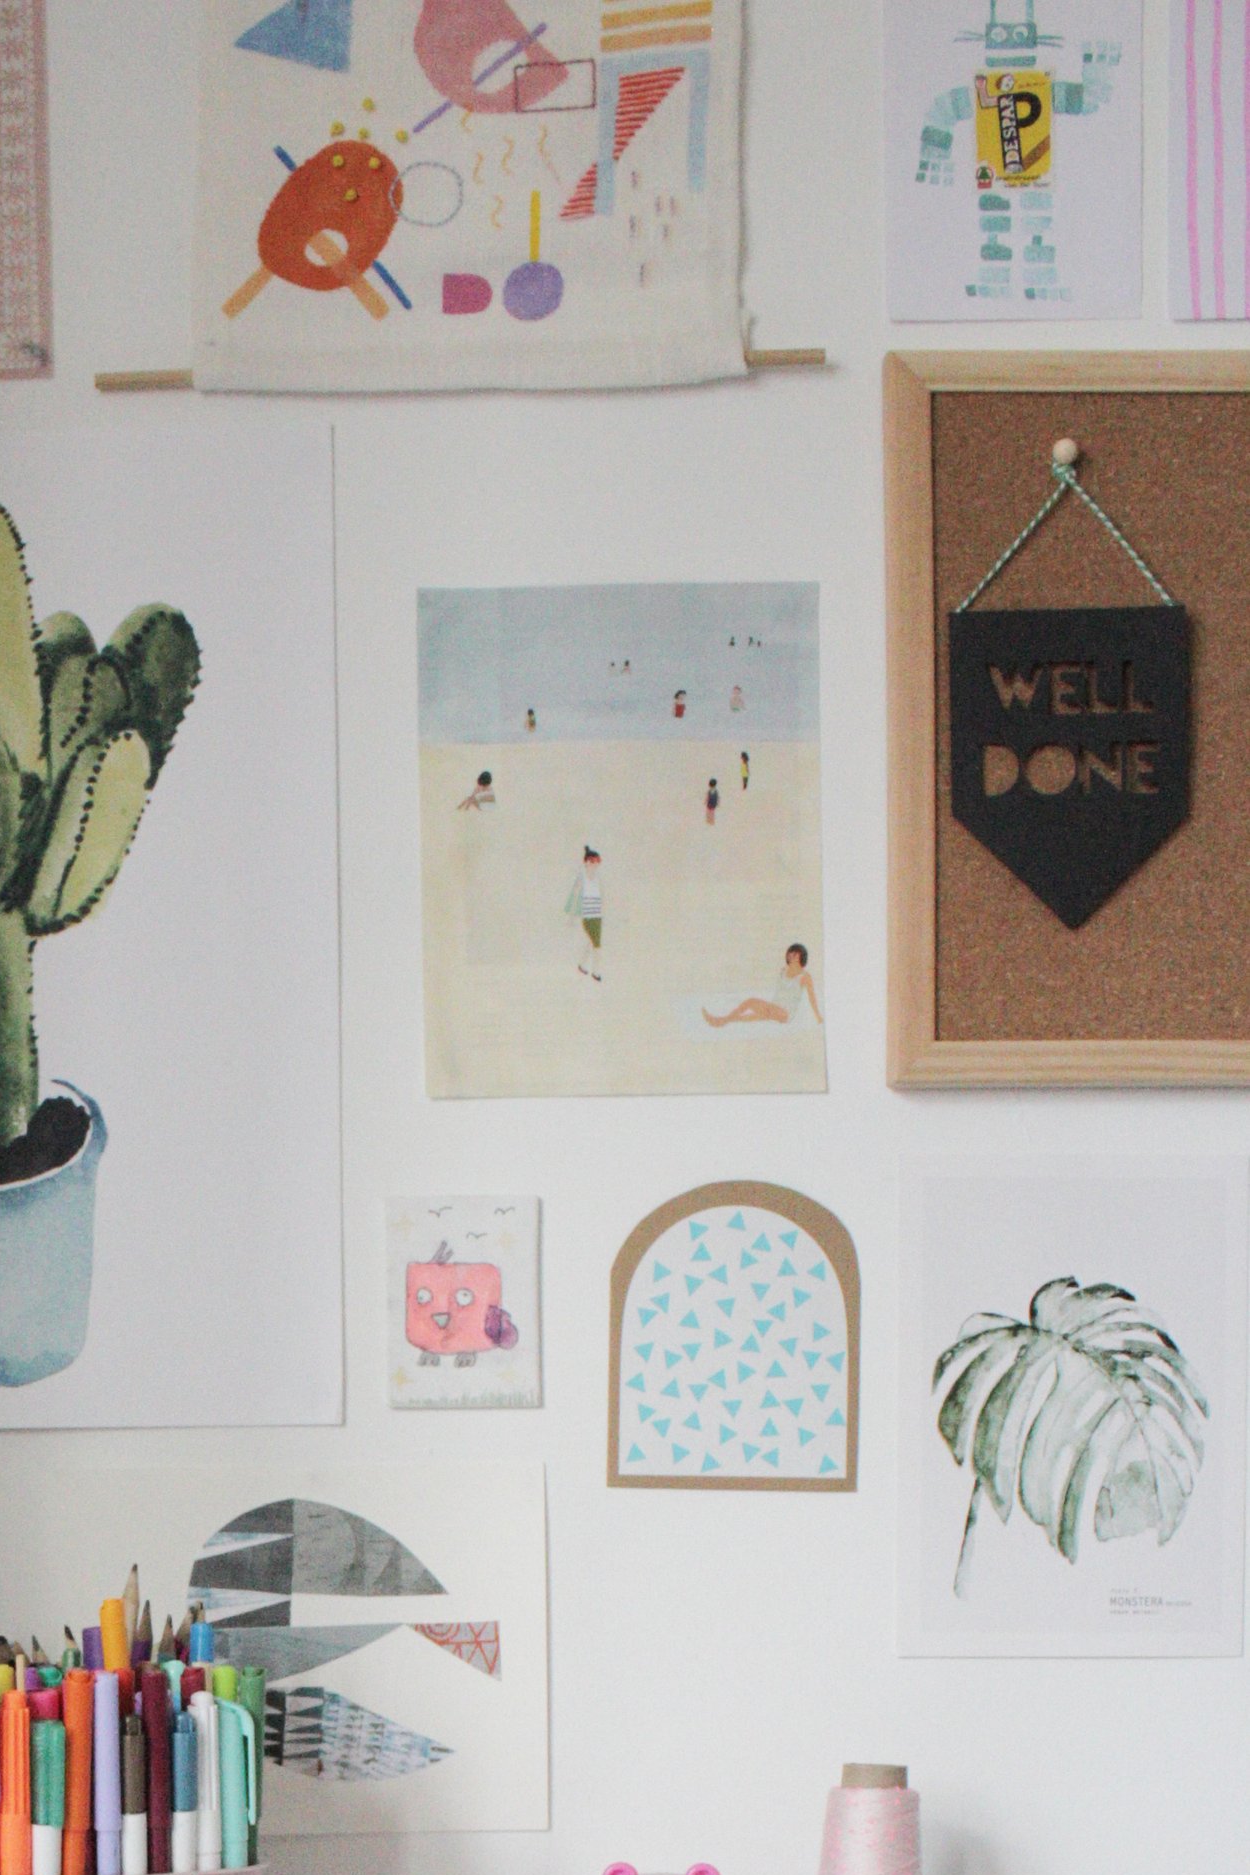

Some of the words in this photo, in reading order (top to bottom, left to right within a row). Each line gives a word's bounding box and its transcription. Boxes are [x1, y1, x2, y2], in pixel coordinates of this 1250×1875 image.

[988, 660, 1155, 715] WELL
[982, 740, 1160, 796] DONE
[1109, 1596, 1163, 1607] MONSTERA
